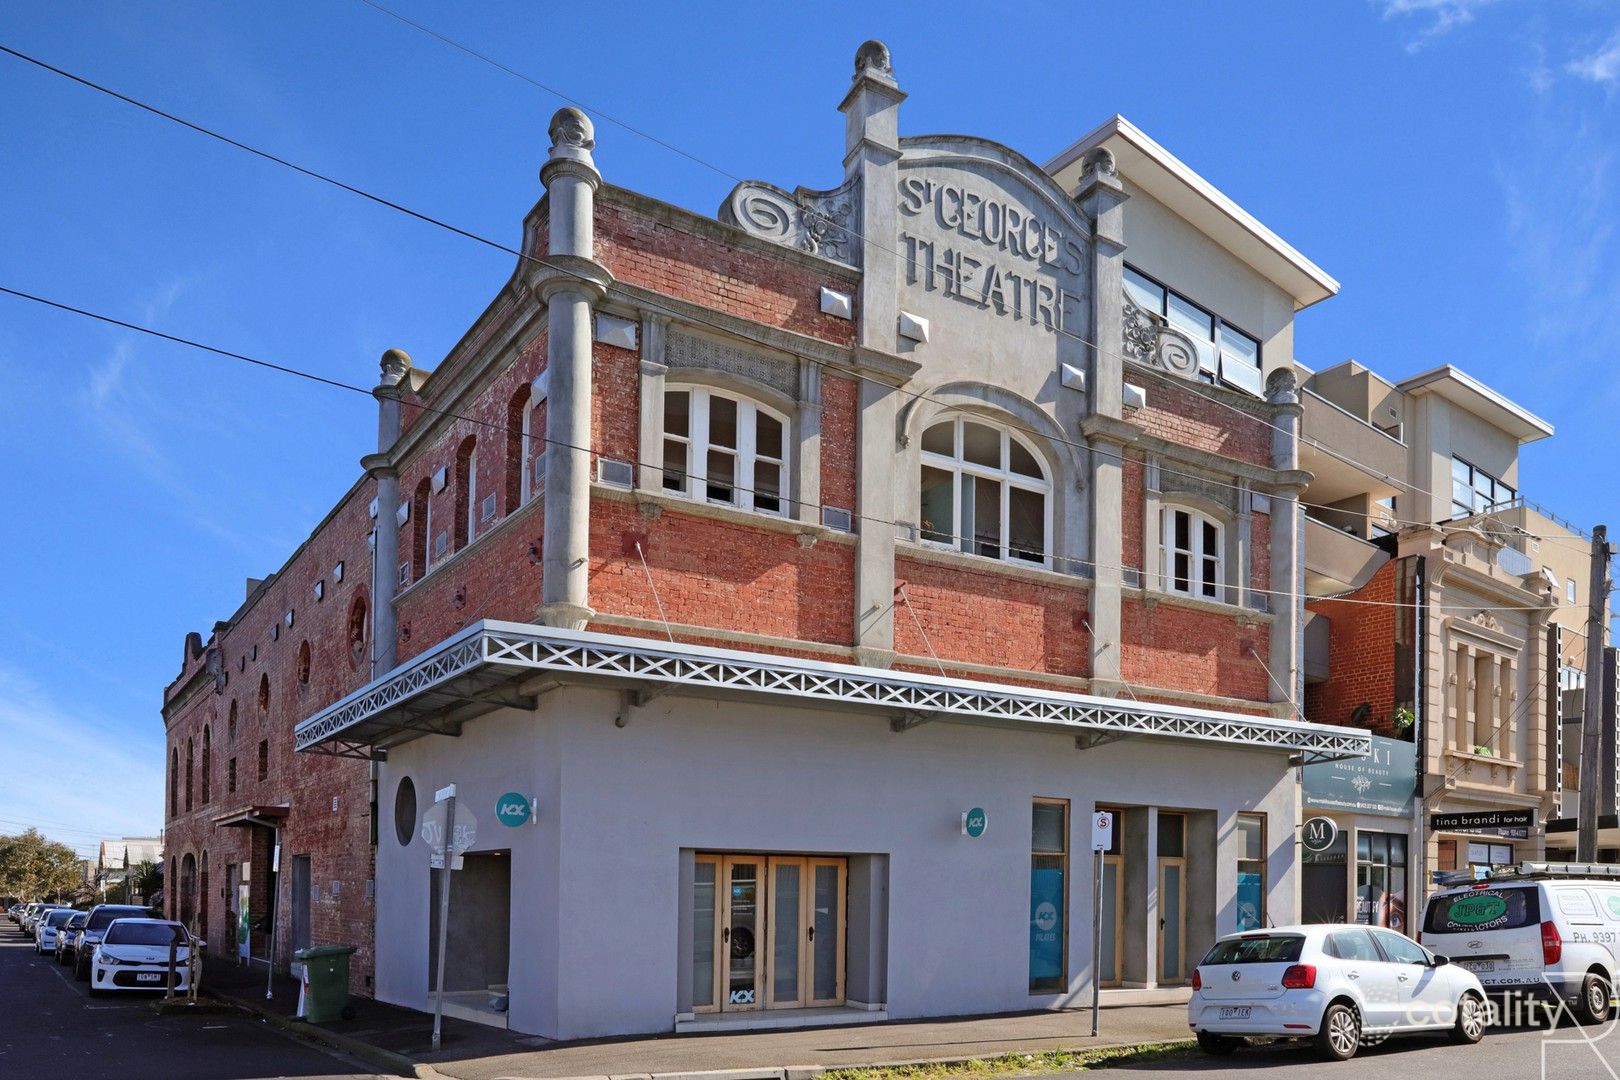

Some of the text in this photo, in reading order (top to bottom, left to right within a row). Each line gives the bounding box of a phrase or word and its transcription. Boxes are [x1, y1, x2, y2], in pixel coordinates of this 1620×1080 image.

[939, 182, 1086, 276] GEORGE'S
[900, 231, 1082, 334] THEATRE
[1436, 817, 1458, 826] tina
[1461, 814, 1500, 825] brandi
[1309, 822, 1325, 839] M
[1453, 890, 1504, 903] ELECTRICAL
[1593, 932, 1616, 943] 9397
[730, 990, 754, 1003] KX
